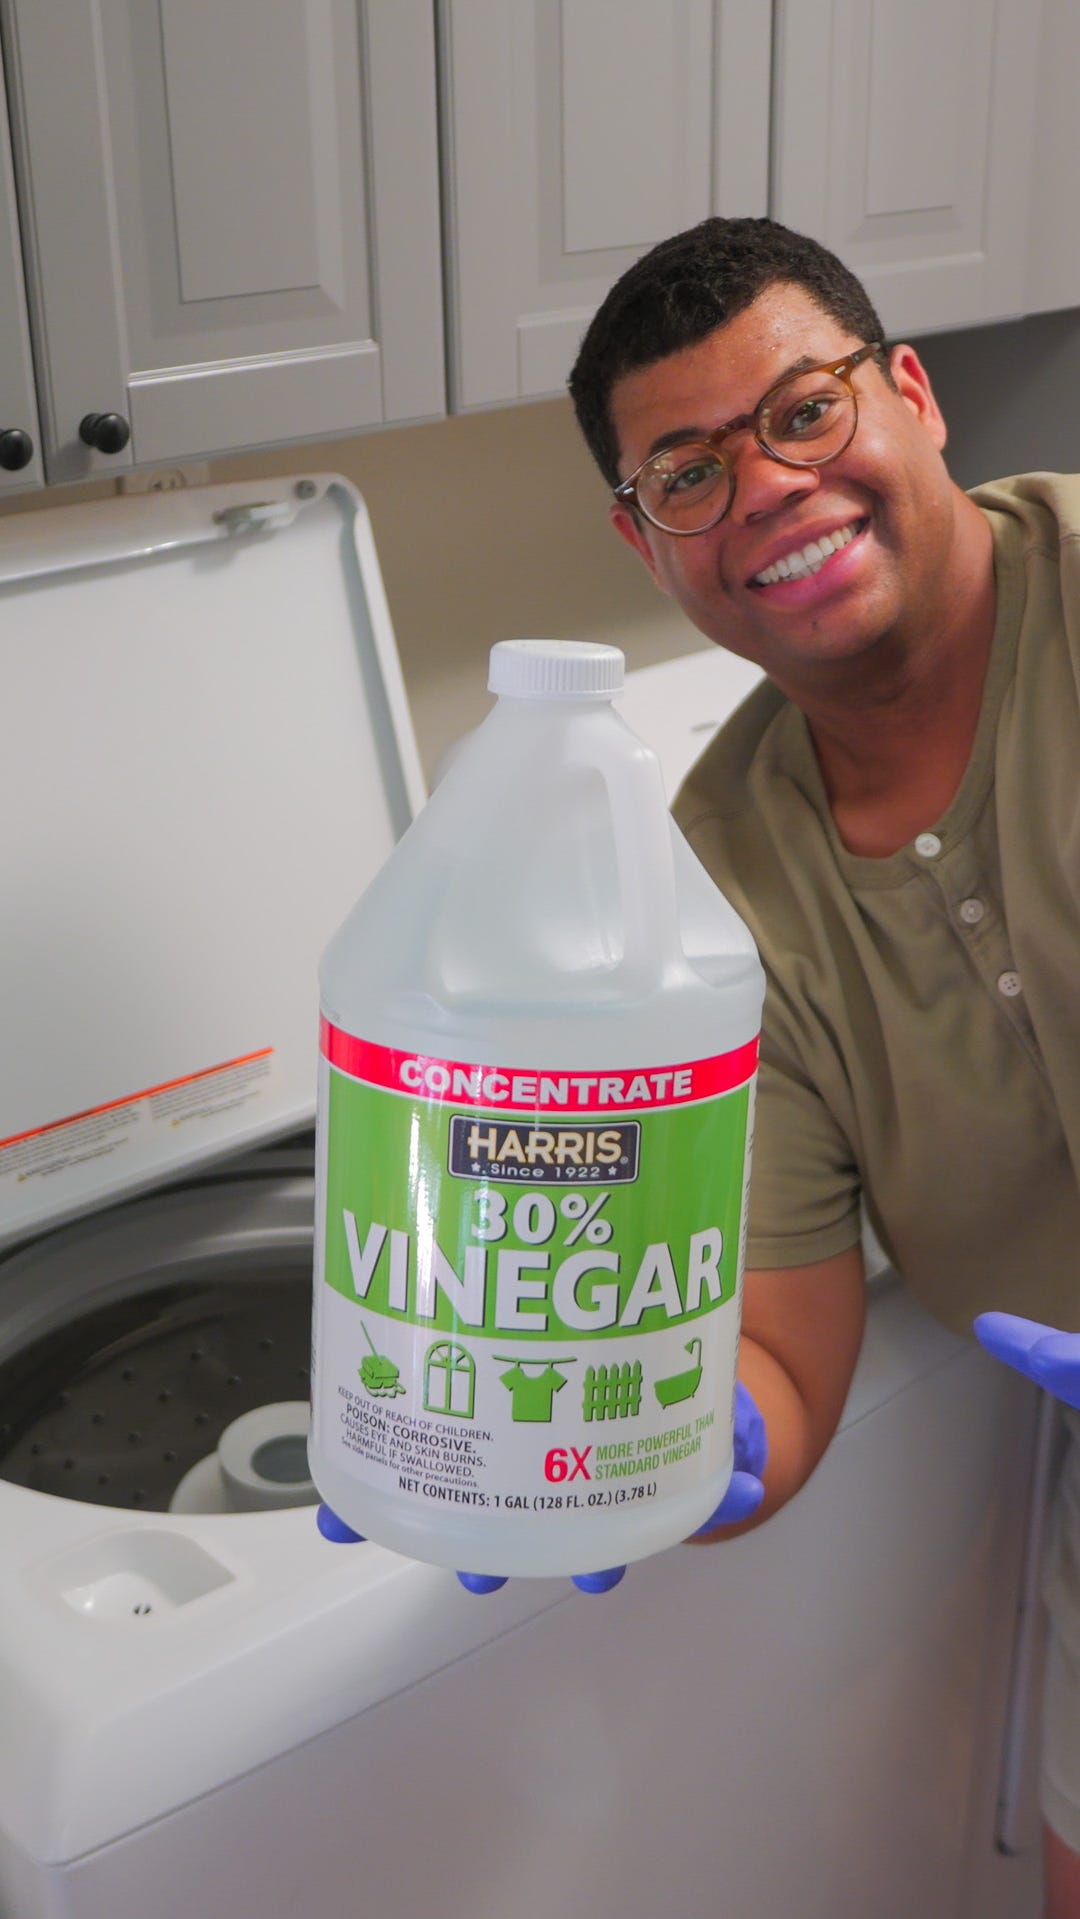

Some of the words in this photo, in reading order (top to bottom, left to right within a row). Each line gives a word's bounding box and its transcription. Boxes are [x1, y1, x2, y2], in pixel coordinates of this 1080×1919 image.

[399, 1059, 692, 1105] CONCENTRATE
[467, 1125, 624, 1165] HARRIS
[490, 1162, 544, 1178] Since
[555, 1165, 601, 1178] 1922
[470, 1188, 614, 1246] 30%
[343, 1208, 723, 1331] VINEGAR
[337, 1384, 354, 1400] KEEP
[354, 1395, 371, 1410] OUT
[372, 1404, 384, 1416] OF
[385, 1409, 417, 1428] REACH
[418, 1420, 433, 1431] OF
[435, 1423, 495, 1442] CHILDREN.
[346, 1402, 391, 1434] POISON:
[392, 1424, 477, 1455] CORROSIVE.
[596, 1441, 634, 1461] MORE
[637, 1422, 693, 1454] POWERFUL
[695, 1408, 715, 1434] THAN
[340, 1413, 370, 1437] CAUSES
[371, 1429, 388, 1445] EYE
[389, 1437, 412, 1452] AND
[414, 1444, 441, 1460] SKIN
[442, 1451, 487, 1468] BURNS.
[346, 1427, 387, 1457] HARMFUL
[389, 1448, 398, 1459] IF
[400, 1452, 475, 1479] SWALLOWED.
[543, 1445, 593, 1483] 6X
[595, 1453, 660, 1481] STANDARD
[662, 1436, 702, 1466] VINEGAR
[389, 1460, 400, 1470] for
[401, 1465, 423, 1477] other
[398, 1475, 420, 1494] NET
[422, 1483, 490, 1508] CONTENTS:
[494, 1496, 500, 1508] 1
[505, 1496, 530, 1510] GAL
[533, 1496, 563, 1512] (128
[566, 1496, 585, 1509] FL.
[588, 1491, 612, 1507] OZ.)
[615, 1486, 644, 1505] (3.78
[647, 1482, 657, 1497] L)
